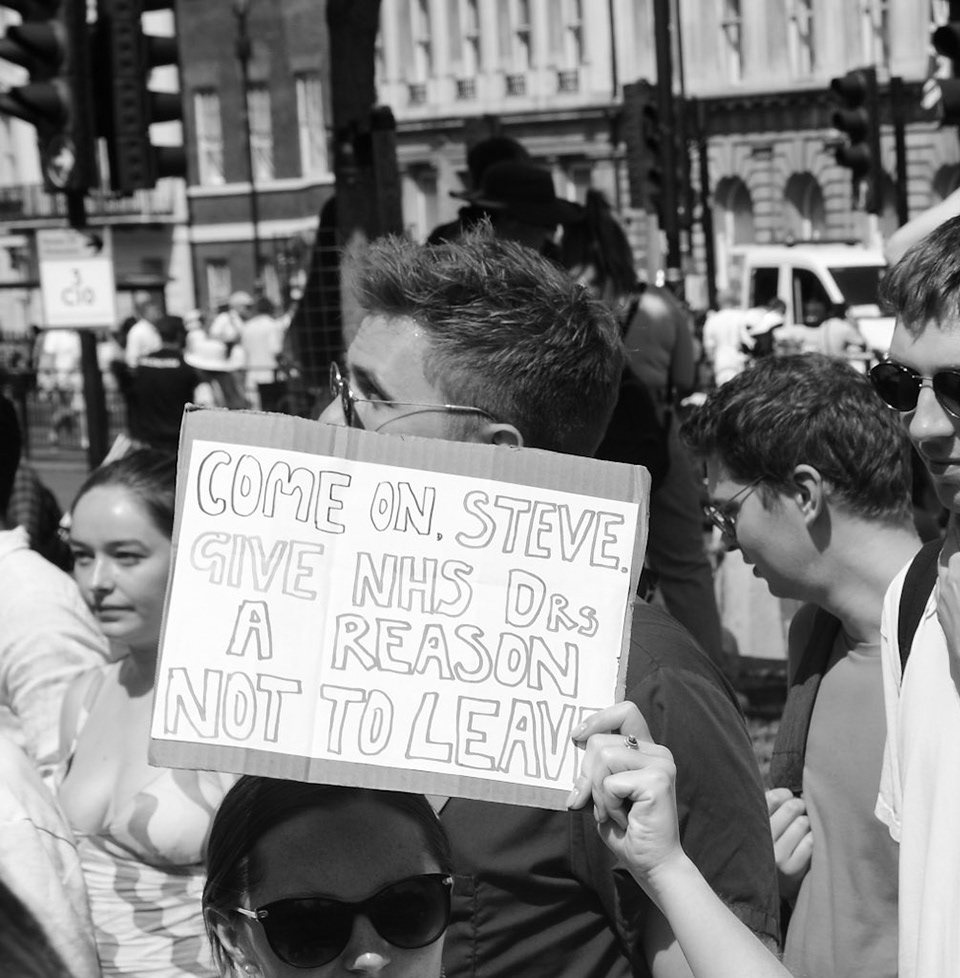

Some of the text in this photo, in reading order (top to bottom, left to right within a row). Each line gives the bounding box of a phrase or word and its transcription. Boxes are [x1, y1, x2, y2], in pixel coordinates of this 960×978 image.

[197, 450, 351, 534] COME
[455, 490, 628, 573] STEVE.
[190, 530, 324, 600] GIVE
[352, 552, 473, 617] NHS
[226, 600, 579, 698] A REASON
[164, 667, 605, 783] NOT TO LEAV
